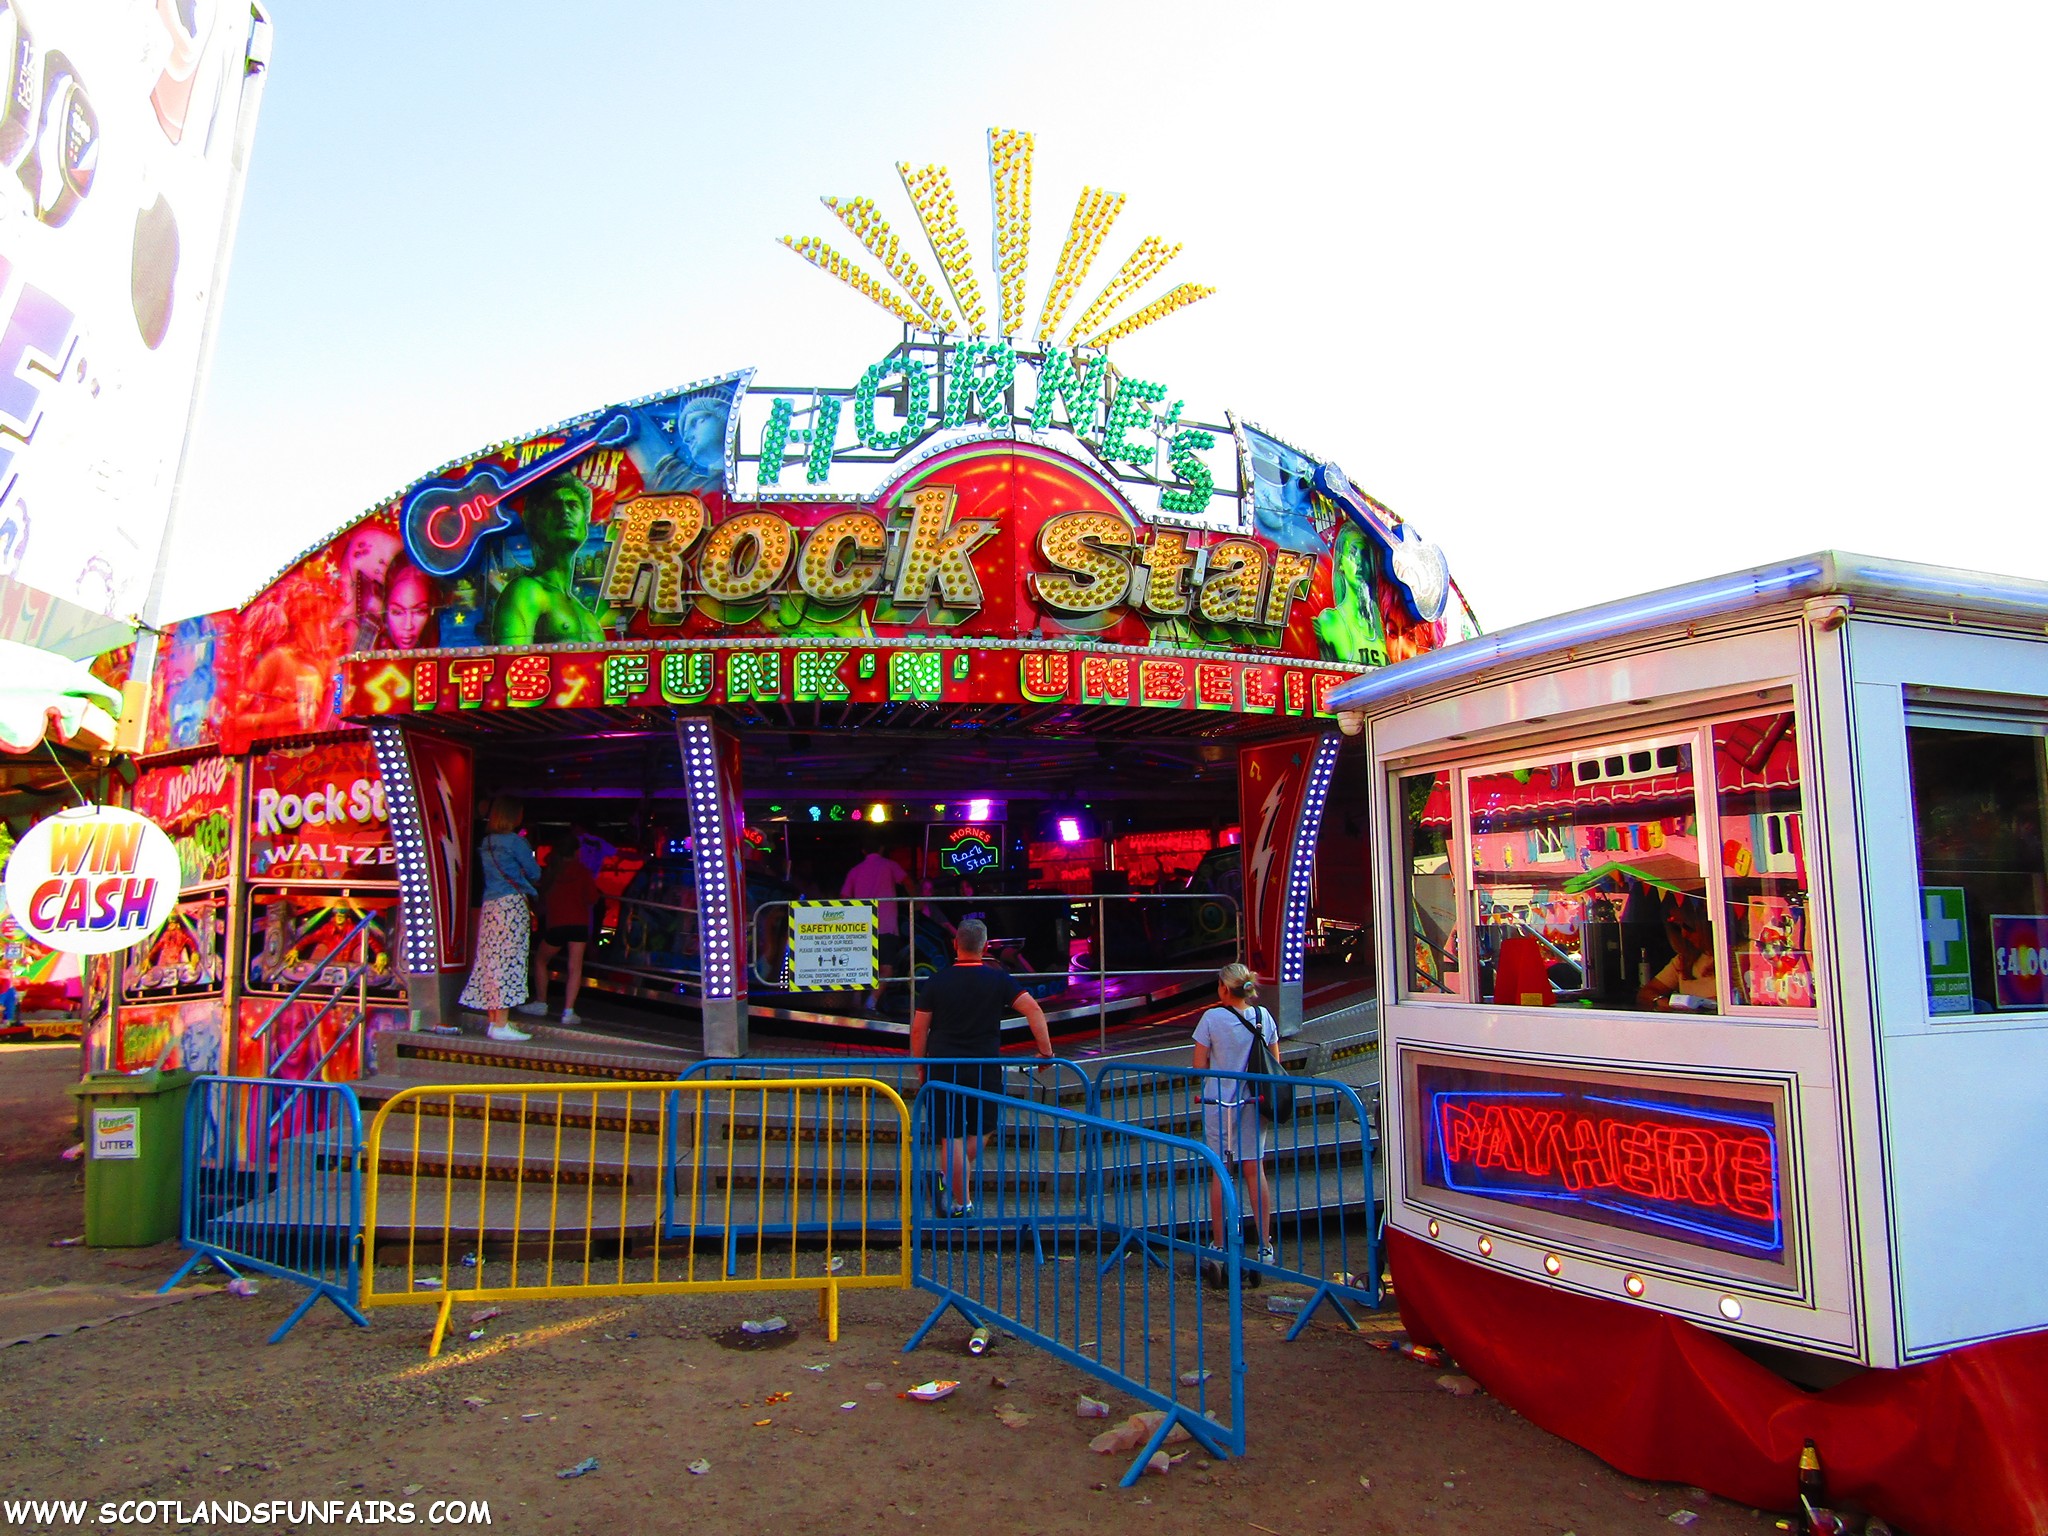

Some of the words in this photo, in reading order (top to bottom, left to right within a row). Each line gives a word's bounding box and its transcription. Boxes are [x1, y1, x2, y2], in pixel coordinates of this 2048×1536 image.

[603, 485, 1000, 614] Rock
[1028, 509, 1318, 626] Star
[414, 655, 550, 711] ITS
[165, 755, 227, 818] MOVERS
[350, 779, 388, 823] St
[51, 822, 146, 876] WIN
[950, 827, 991, 843] HORNES
[264, 843, 397, 865] WALTZE
[966, 854, 993, 871] Star
[29, 878, 158, 934] CASH
[801, 924, 833, 933] SAFETY
[836, 923, 866, 932] NOTICE
[1948, 981, 1968, 992] point
[100, 1139, 134, 1150] LITTER
